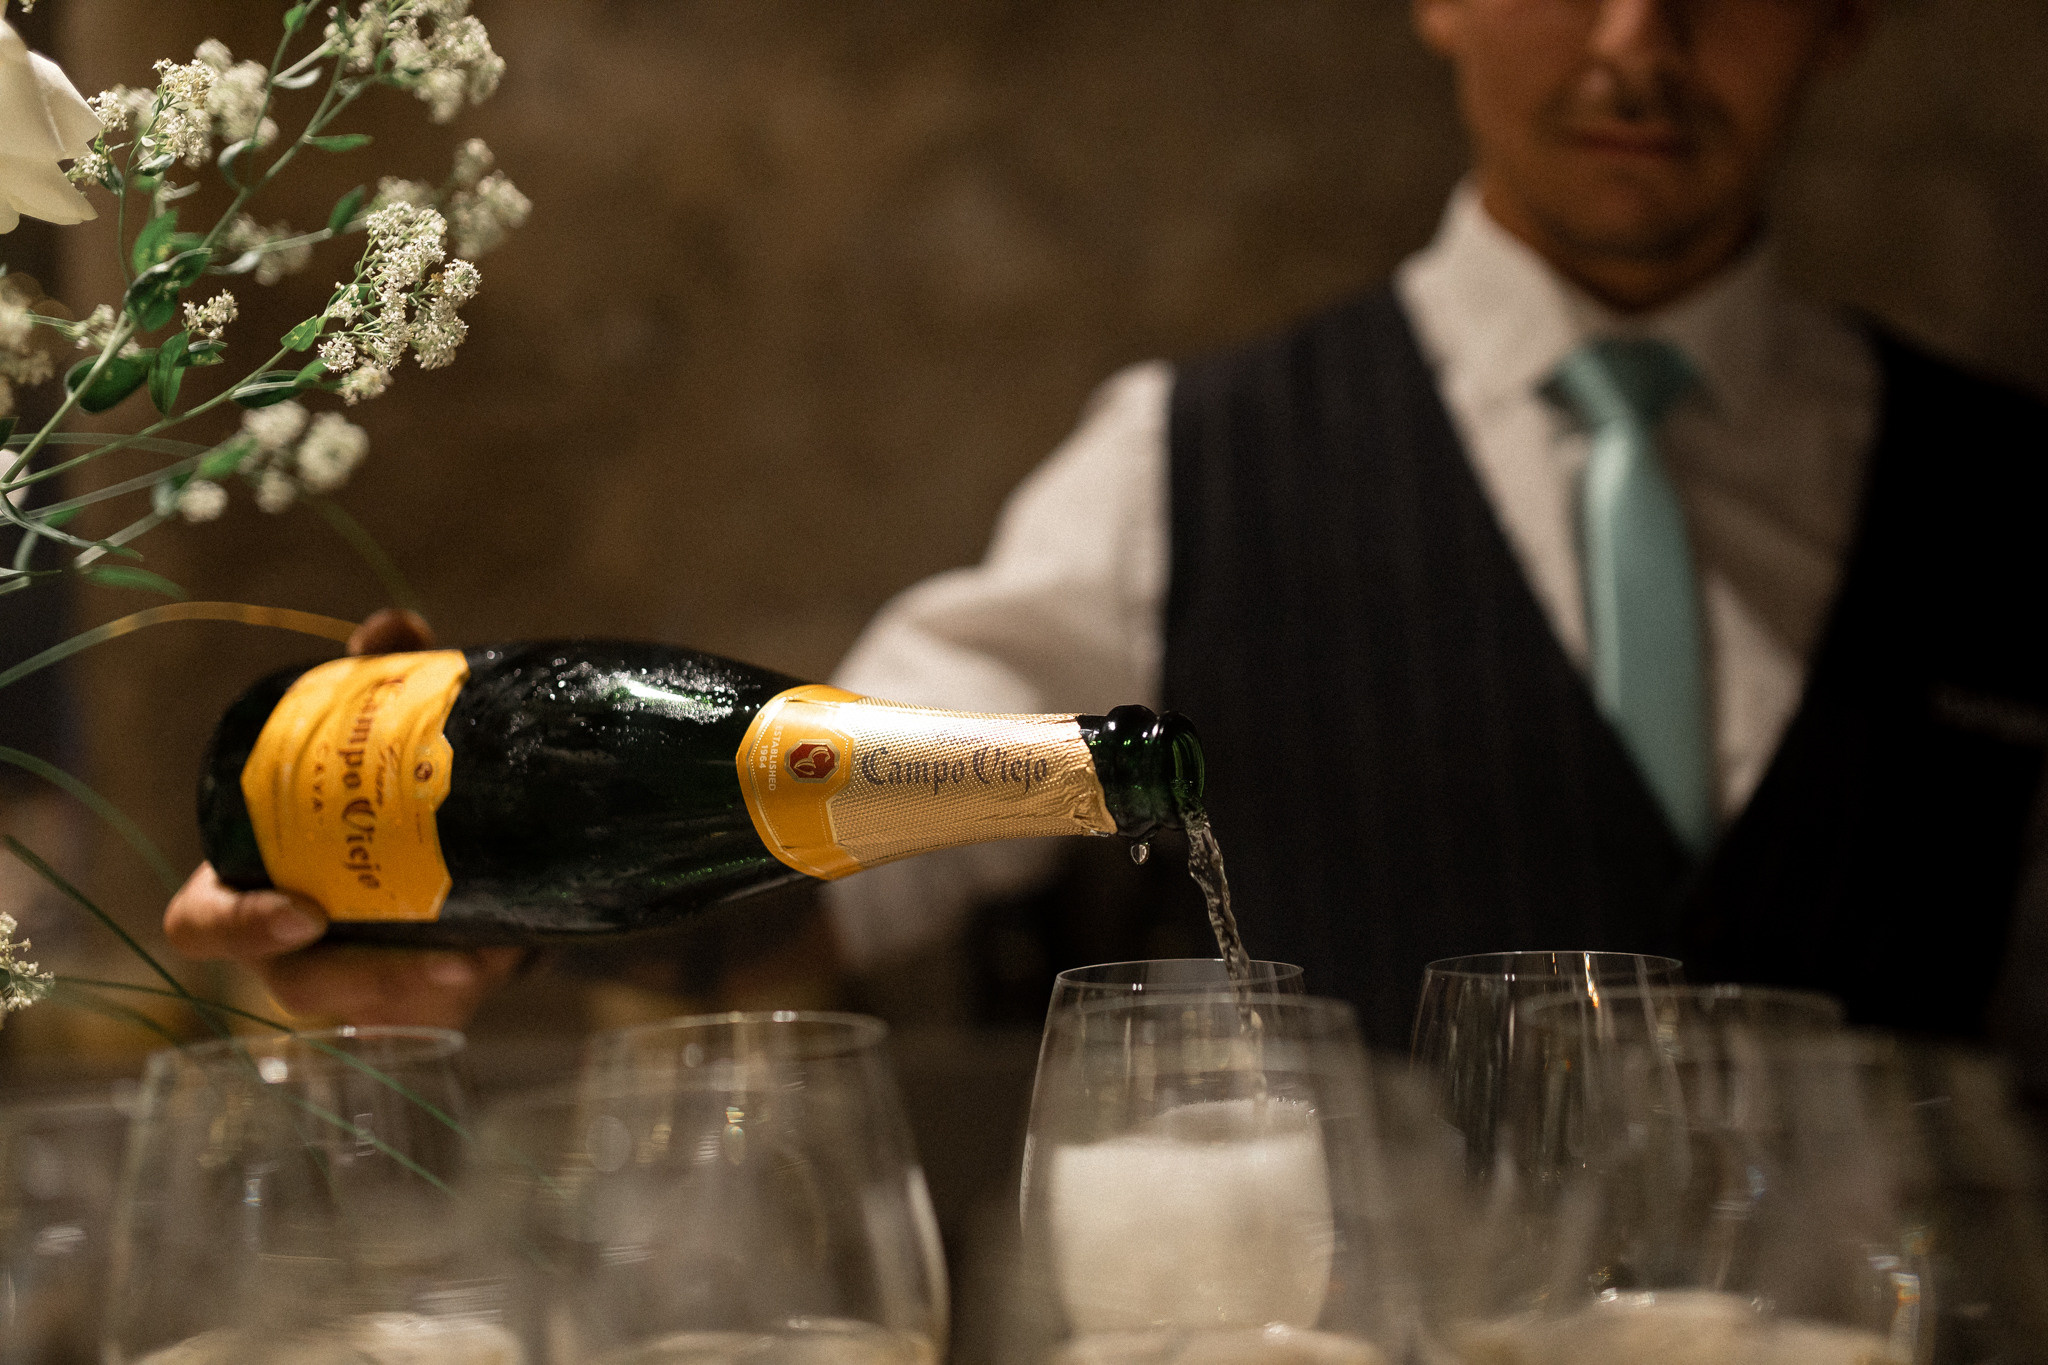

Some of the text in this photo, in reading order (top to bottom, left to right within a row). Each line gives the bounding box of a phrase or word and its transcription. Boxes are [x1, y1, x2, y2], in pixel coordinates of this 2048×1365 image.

[759, 745, 768, 769] 1964
[768, 725, 785, 791] ESTABLISHED
[862, 746, 1048, 796] Campo Viejo
[341, 798, 380, 890] Viejo
